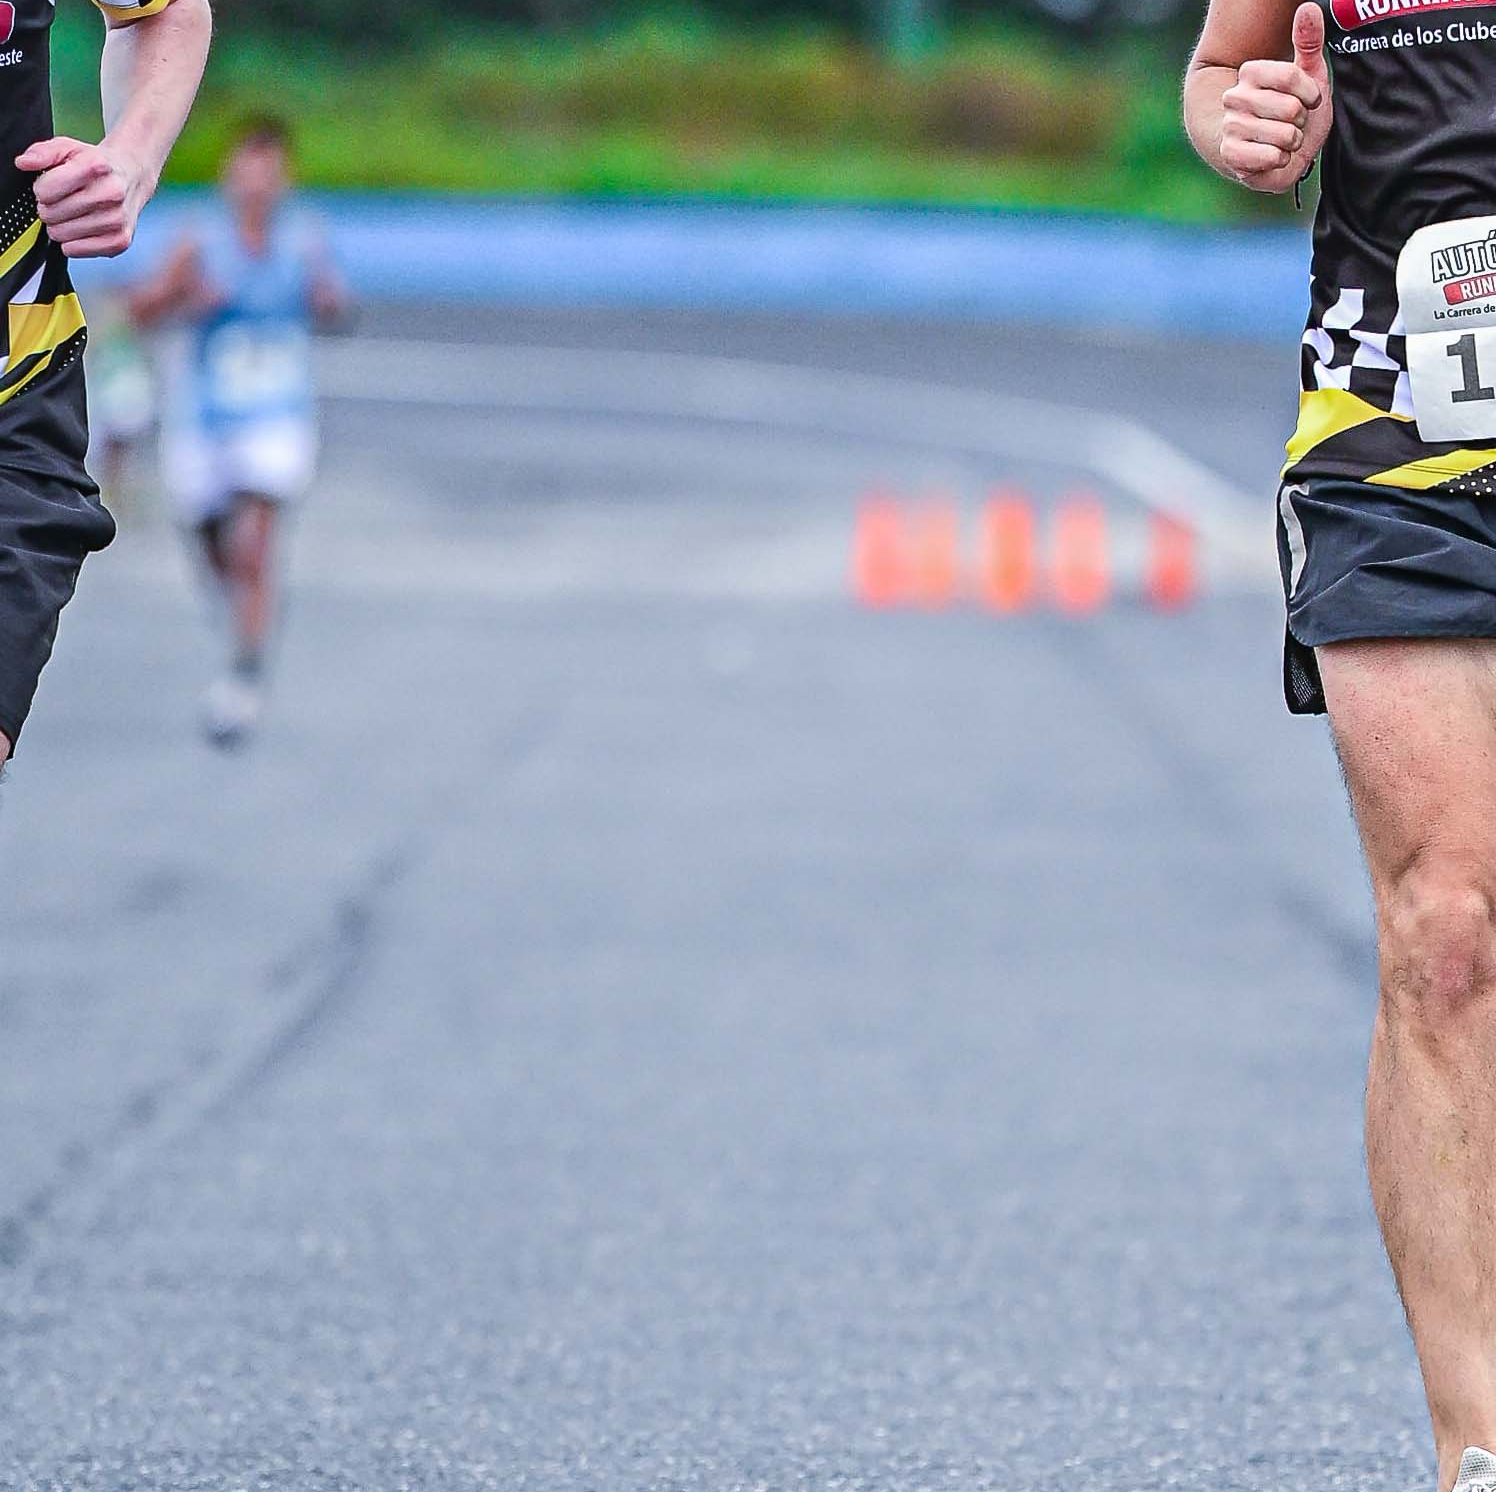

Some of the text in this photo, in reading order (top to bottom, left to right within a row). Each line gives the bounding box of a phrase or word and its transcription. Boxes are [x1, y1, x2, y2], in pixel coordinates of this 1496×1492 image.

[1342, 35, 1389, 53] Carrera
[1391, 28, 1414, 48] de
[1416, 26, 1443, 45] los
[1433, 310, 1445, 320] La
[1447, 305, 1482, 319] Carrera
[1483, 302, 1496, 314] de
